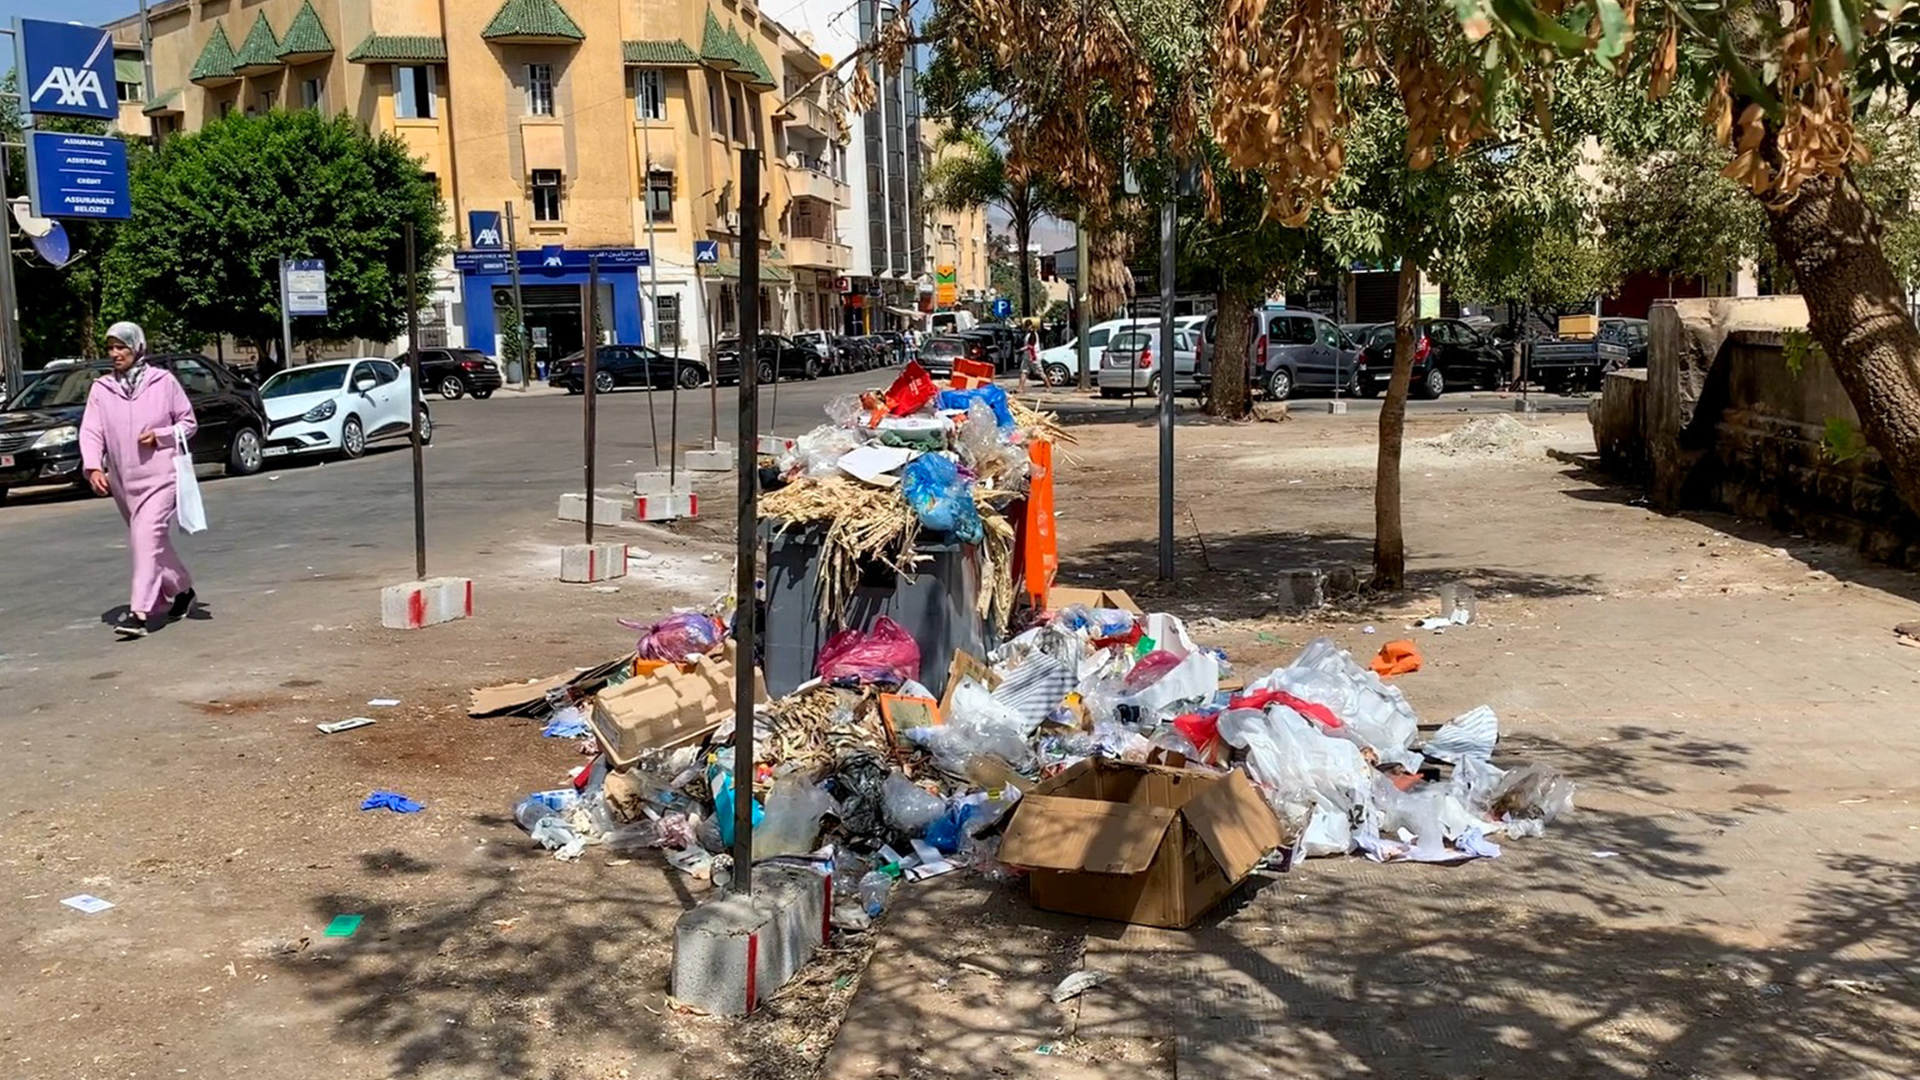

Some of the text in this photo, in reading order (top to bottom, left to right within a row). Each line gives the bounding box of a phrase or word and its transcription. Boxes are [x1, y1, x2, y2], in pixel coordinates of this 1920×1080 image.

[31, 63, 109, 109] AXA
[63, 138, 105, 147] ASSURANCE
[66, 157, 107, 166] ASSISTANCE
[64, 196, 115, 205] ASSURANCES
[475, 228, 501, 245] AXA
[998, 300, 1008, 314] P
